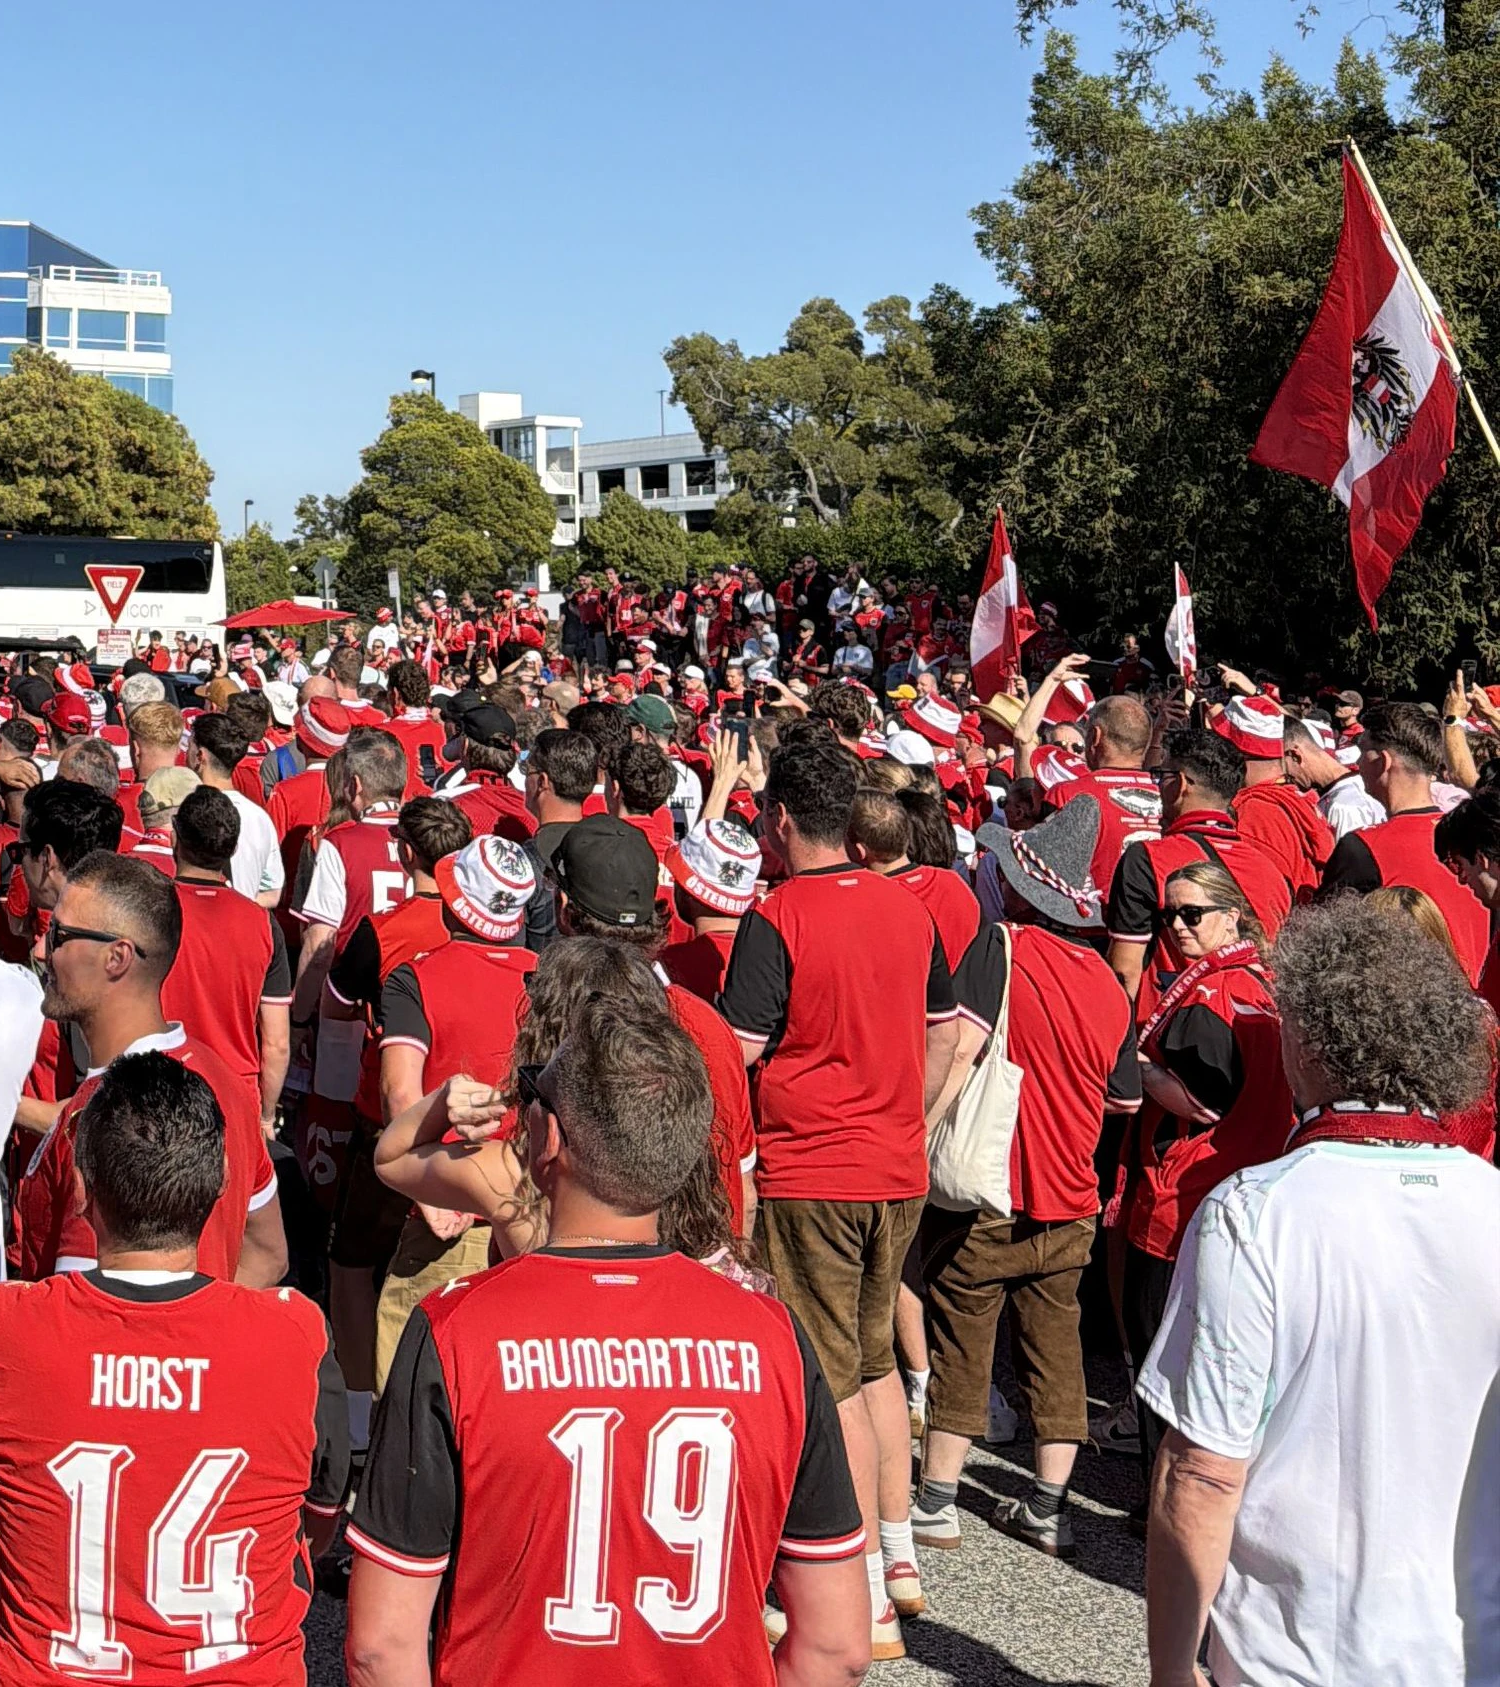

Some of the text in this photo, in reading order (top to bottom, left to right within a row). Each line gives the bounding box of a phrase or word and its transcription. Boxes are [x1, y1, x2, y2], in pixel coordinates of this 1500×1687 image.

[1216, 939, 1256, 959] IMME
[1162, 960, 1210, 1007] WIEDER
[90, 1353, 210, 1412] HORST
[498, 1337, 761, 1394] BAUMGARTNER
[545, 1407, 739, 1645] 19
[46, 1440, 259, 1680] 14
